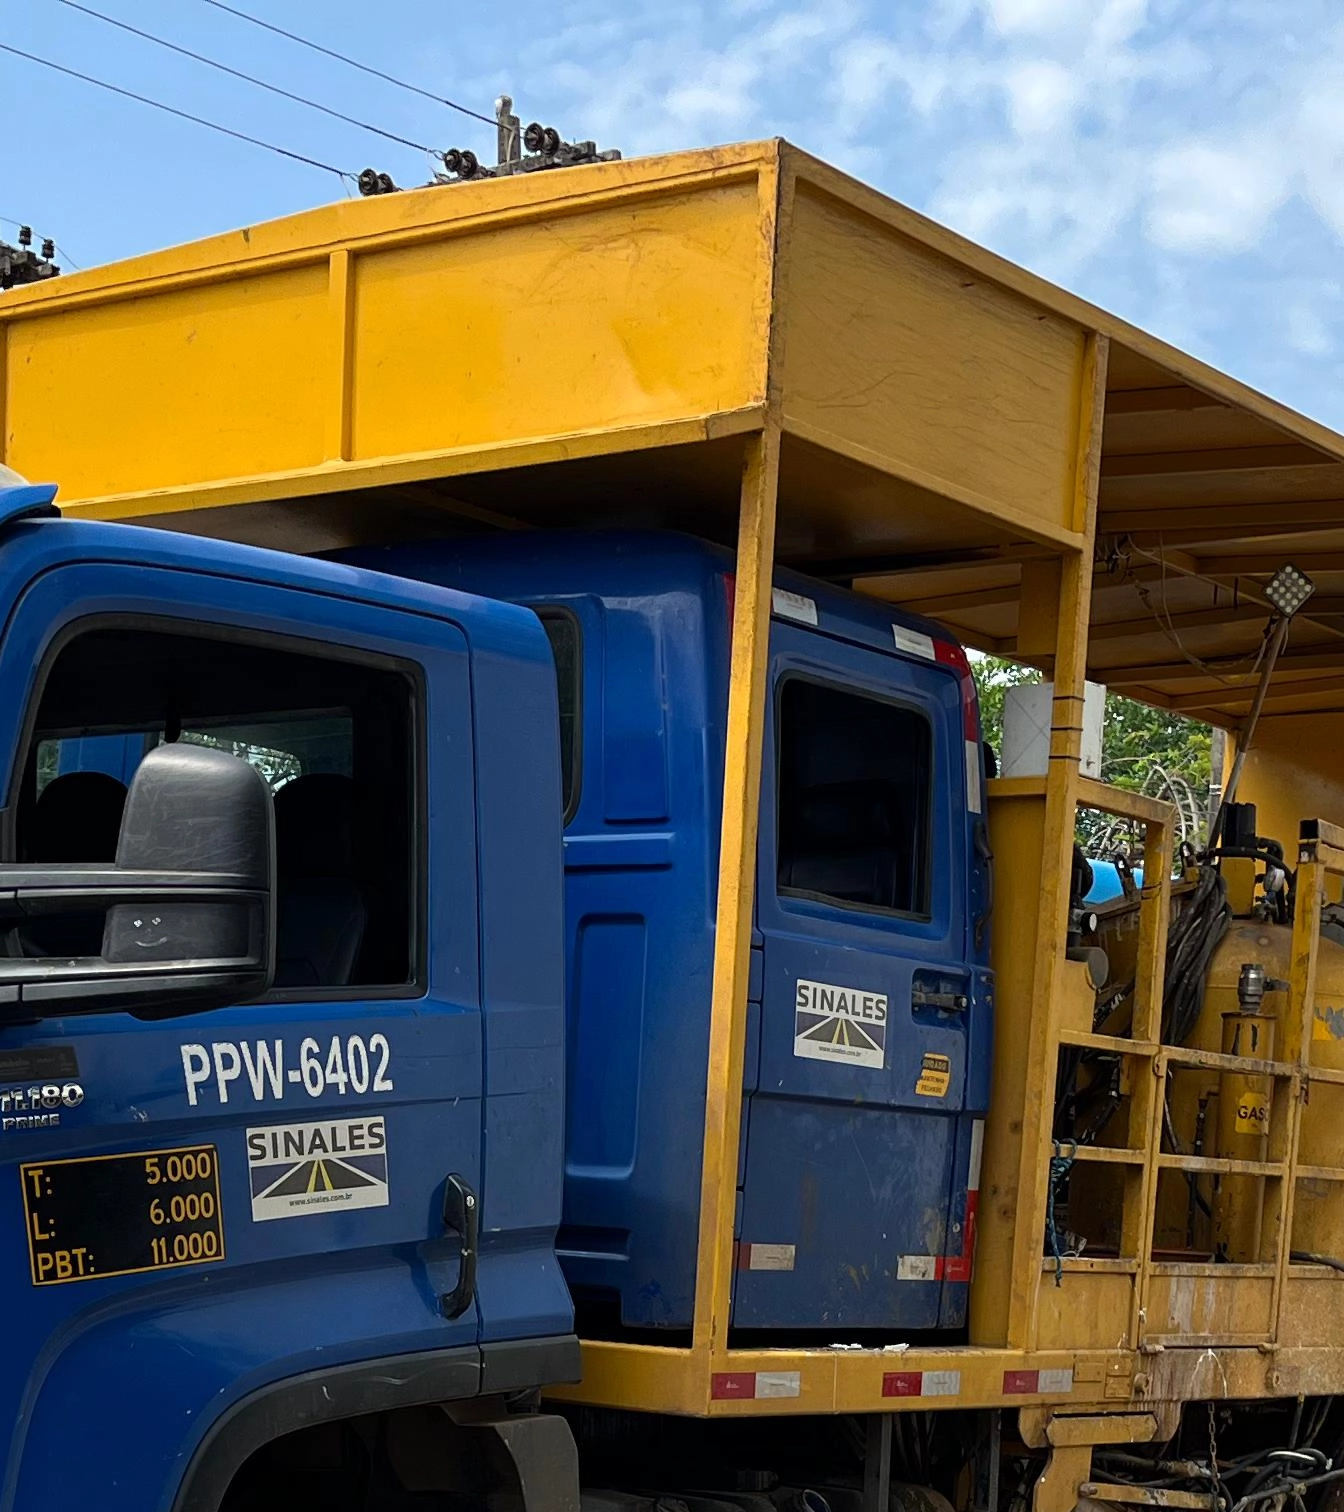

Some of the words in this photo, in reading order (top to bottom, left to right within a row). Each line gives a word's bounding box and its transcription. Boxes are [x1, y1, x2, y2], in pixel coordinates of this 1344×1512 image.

[796, 984, 886, 1021] SINALES
[180, 1033, 394, 1106] PPW-6402
[2, 1113, 61, 1131] PRIME
[247, 1121, 385, 1162] SINALES
[28, 1169, 53, 1198] T:
[145, 1152, 212, 1185] 5.000
[32, 1212, 56, 1241] L:
[149, 1191, 215, 1225] 6.000
[288, 1192, 353, 1207] www.sinales.com.br
[37, 1247, 95, 1281] PBT:
[151, 1230, 217, 1264] 11.000
